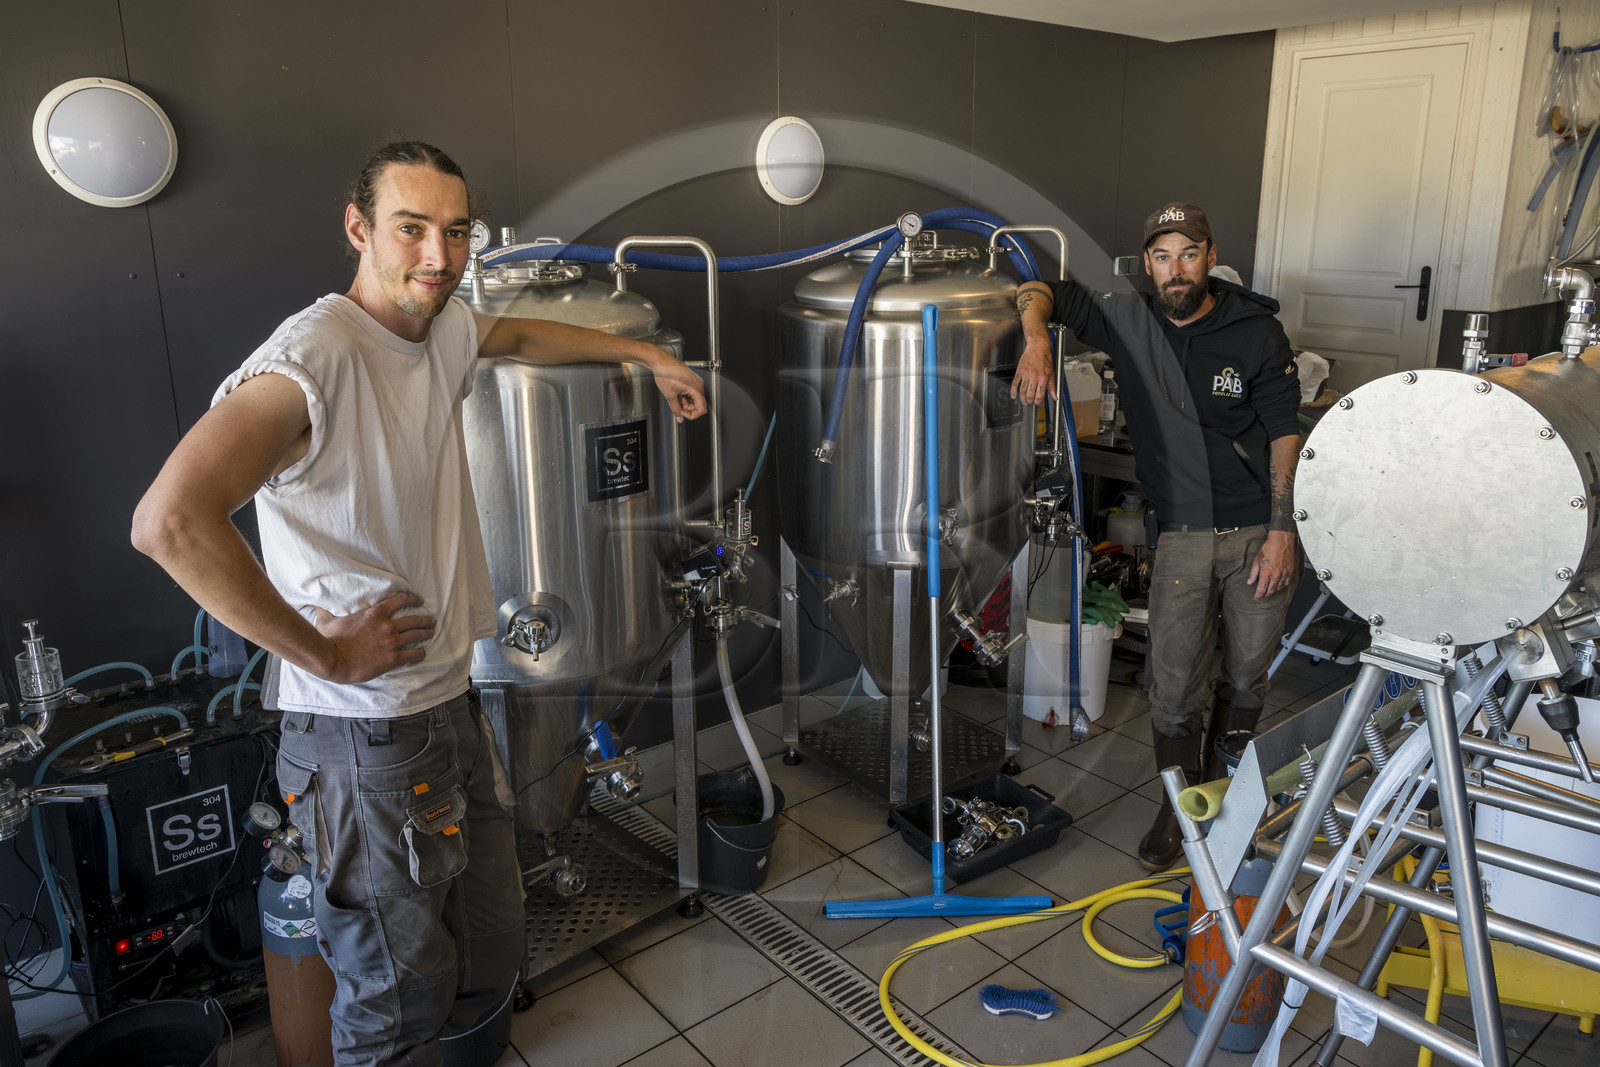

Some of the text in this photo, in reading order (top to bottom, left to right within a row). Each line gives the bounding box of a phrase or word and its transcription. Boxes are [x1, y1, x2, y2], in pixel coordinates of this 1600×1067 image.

[1158, 209, 1185, 224] PAB
[1212, 374, 1243, 394] PAB
[603, 448, 636, 476] Ss
[202, 794, 221, 807] 304
[162, 813, 222, 851] Ss
[172, 841, 218, 862] brewtech
